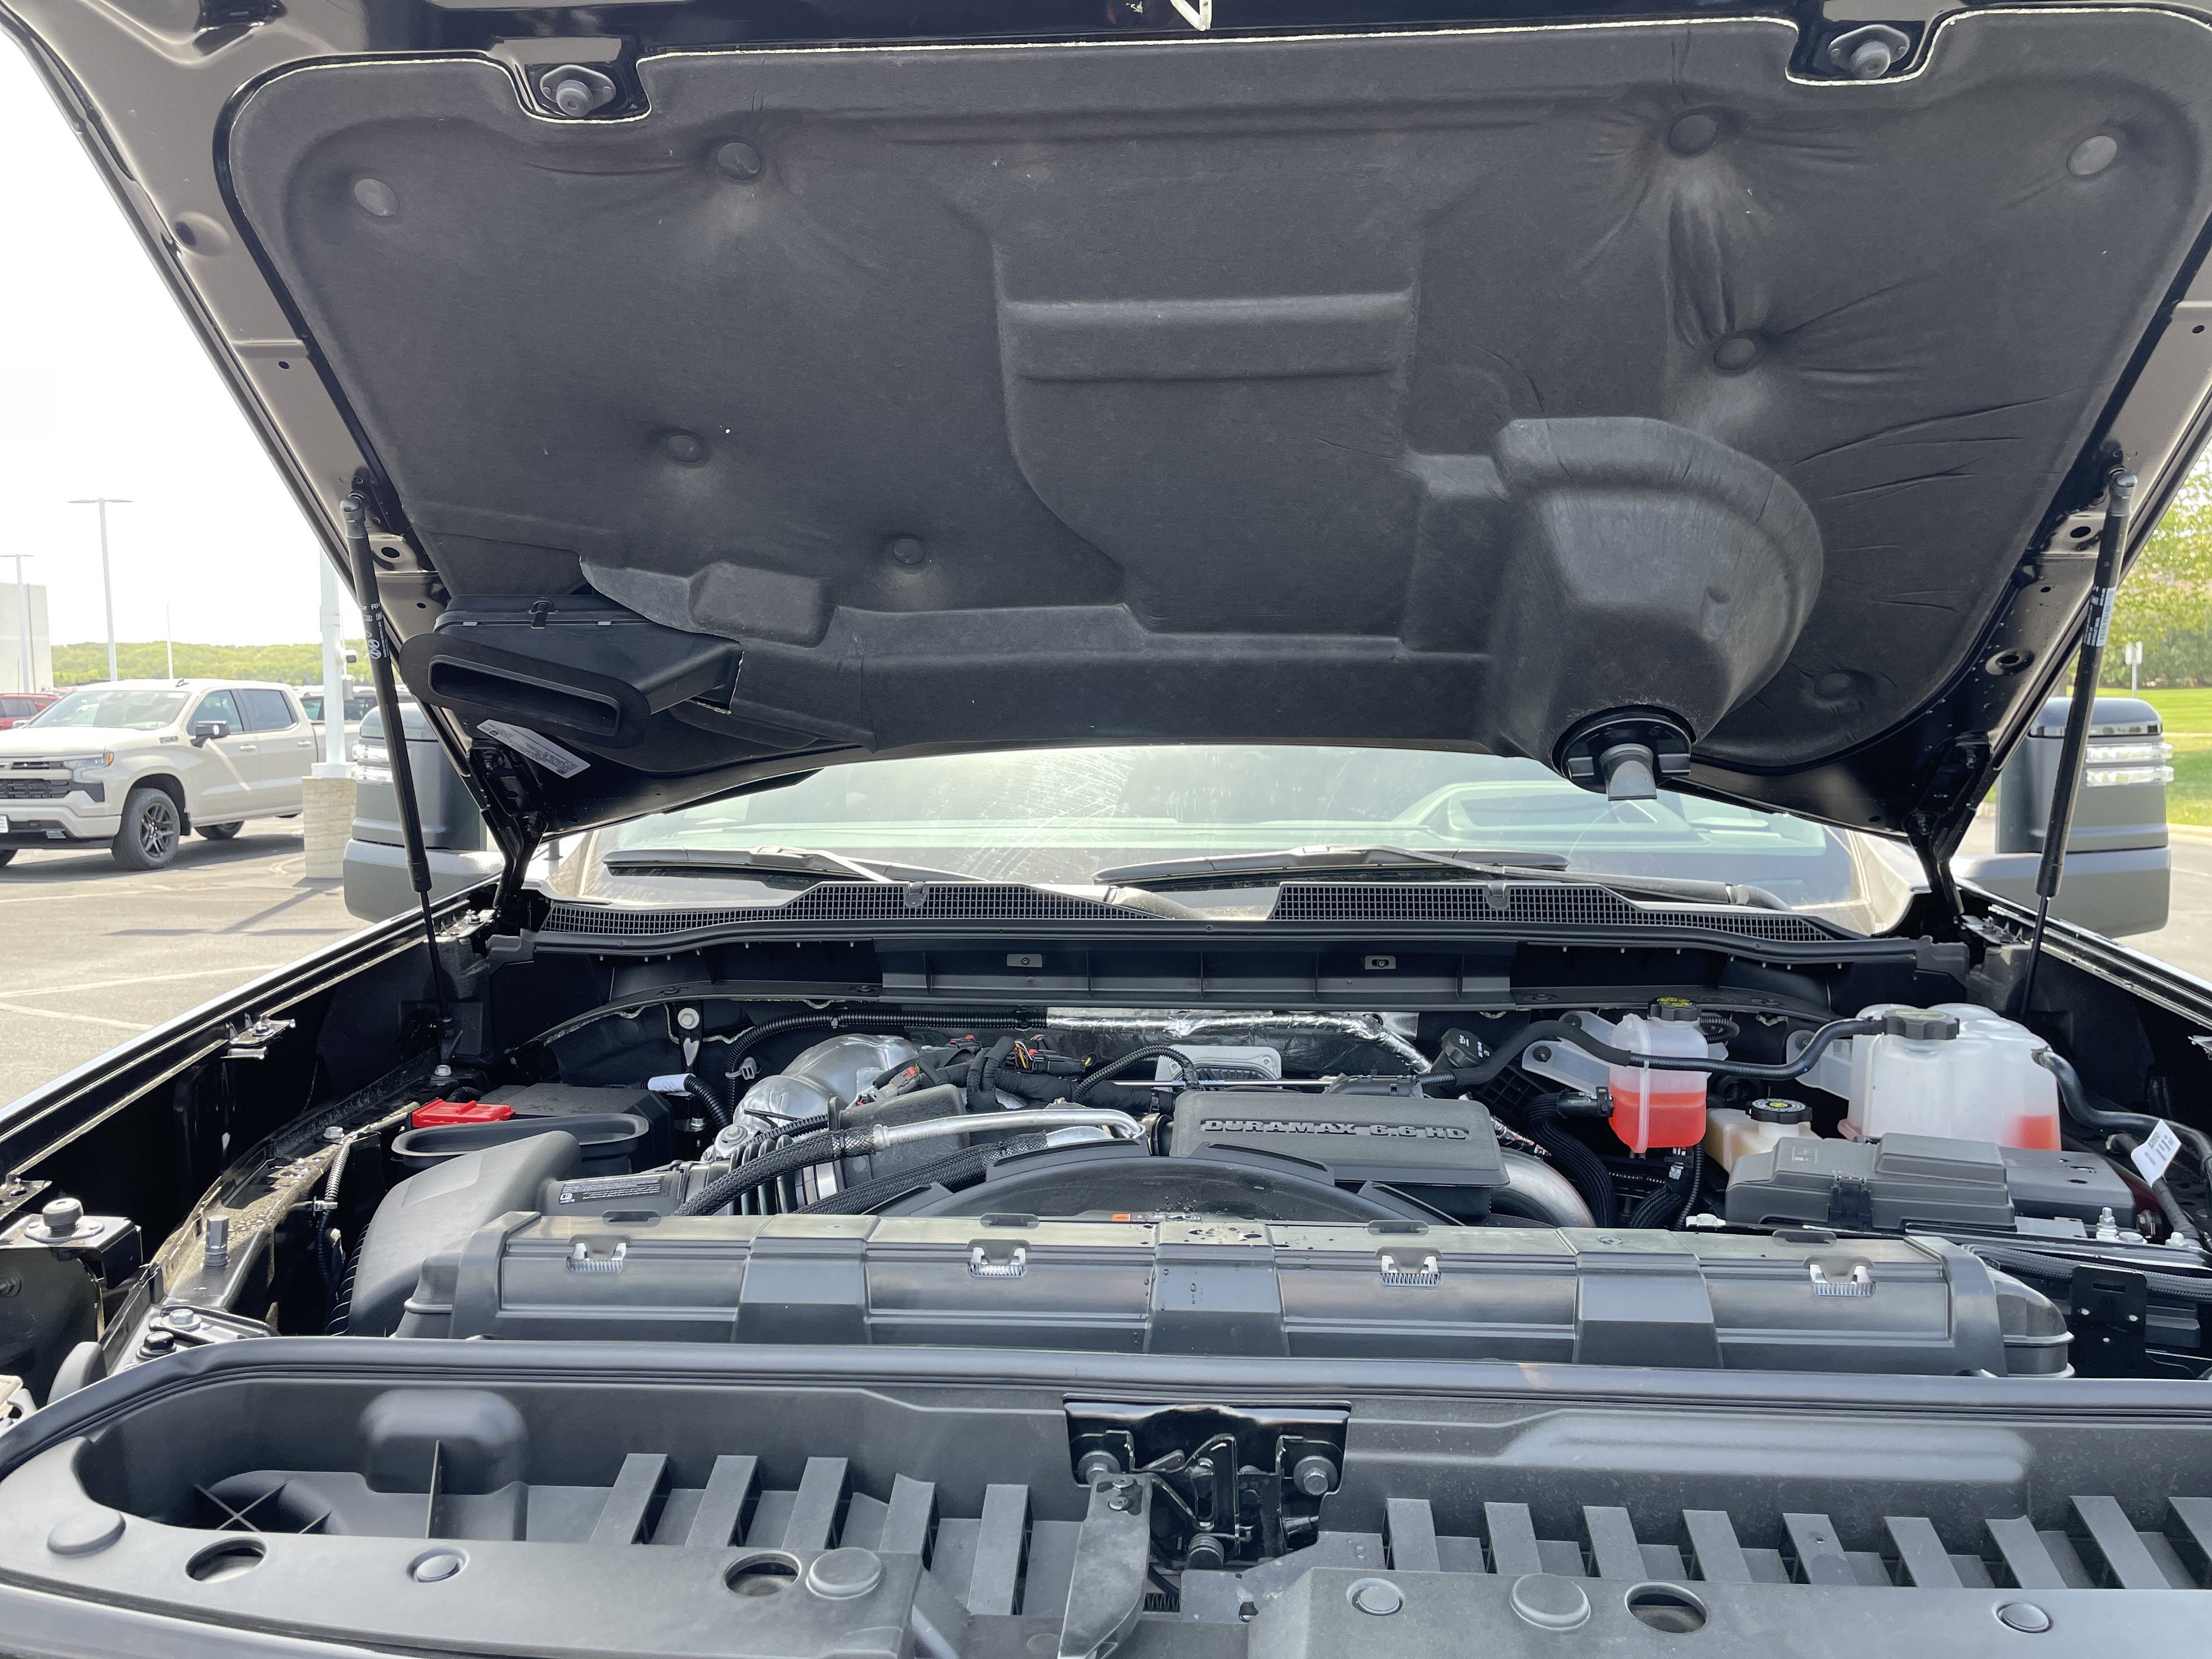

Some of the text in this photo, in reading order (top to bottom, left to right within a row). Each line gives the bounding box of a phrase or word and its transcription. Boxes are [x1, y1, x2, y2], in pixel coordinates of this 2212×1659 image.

[1205, 1120, 1466, 1140] DURAMAX 6.6 HD
